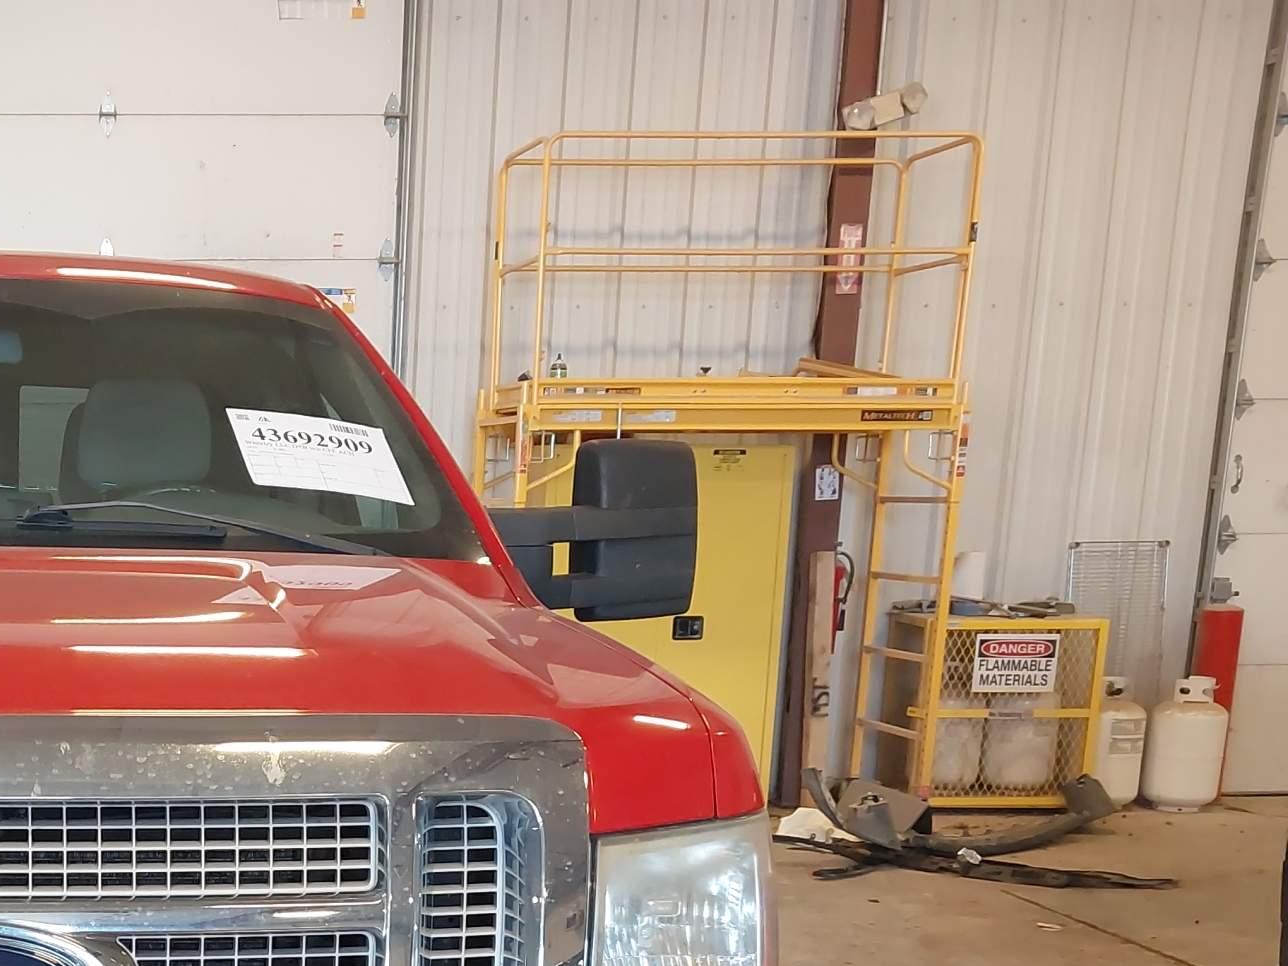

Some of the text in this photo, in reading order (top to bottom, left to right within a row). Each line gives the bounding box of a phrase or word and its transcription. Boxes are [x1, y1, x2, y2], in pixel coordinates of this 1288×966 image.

[251, 427, 373, 454] 43692909
[989, 643, 1046, 654] DANGER
[978, 660, 1053, 671] FLAMMABLE
[979, 674, 1048, 686] MATERIALS
